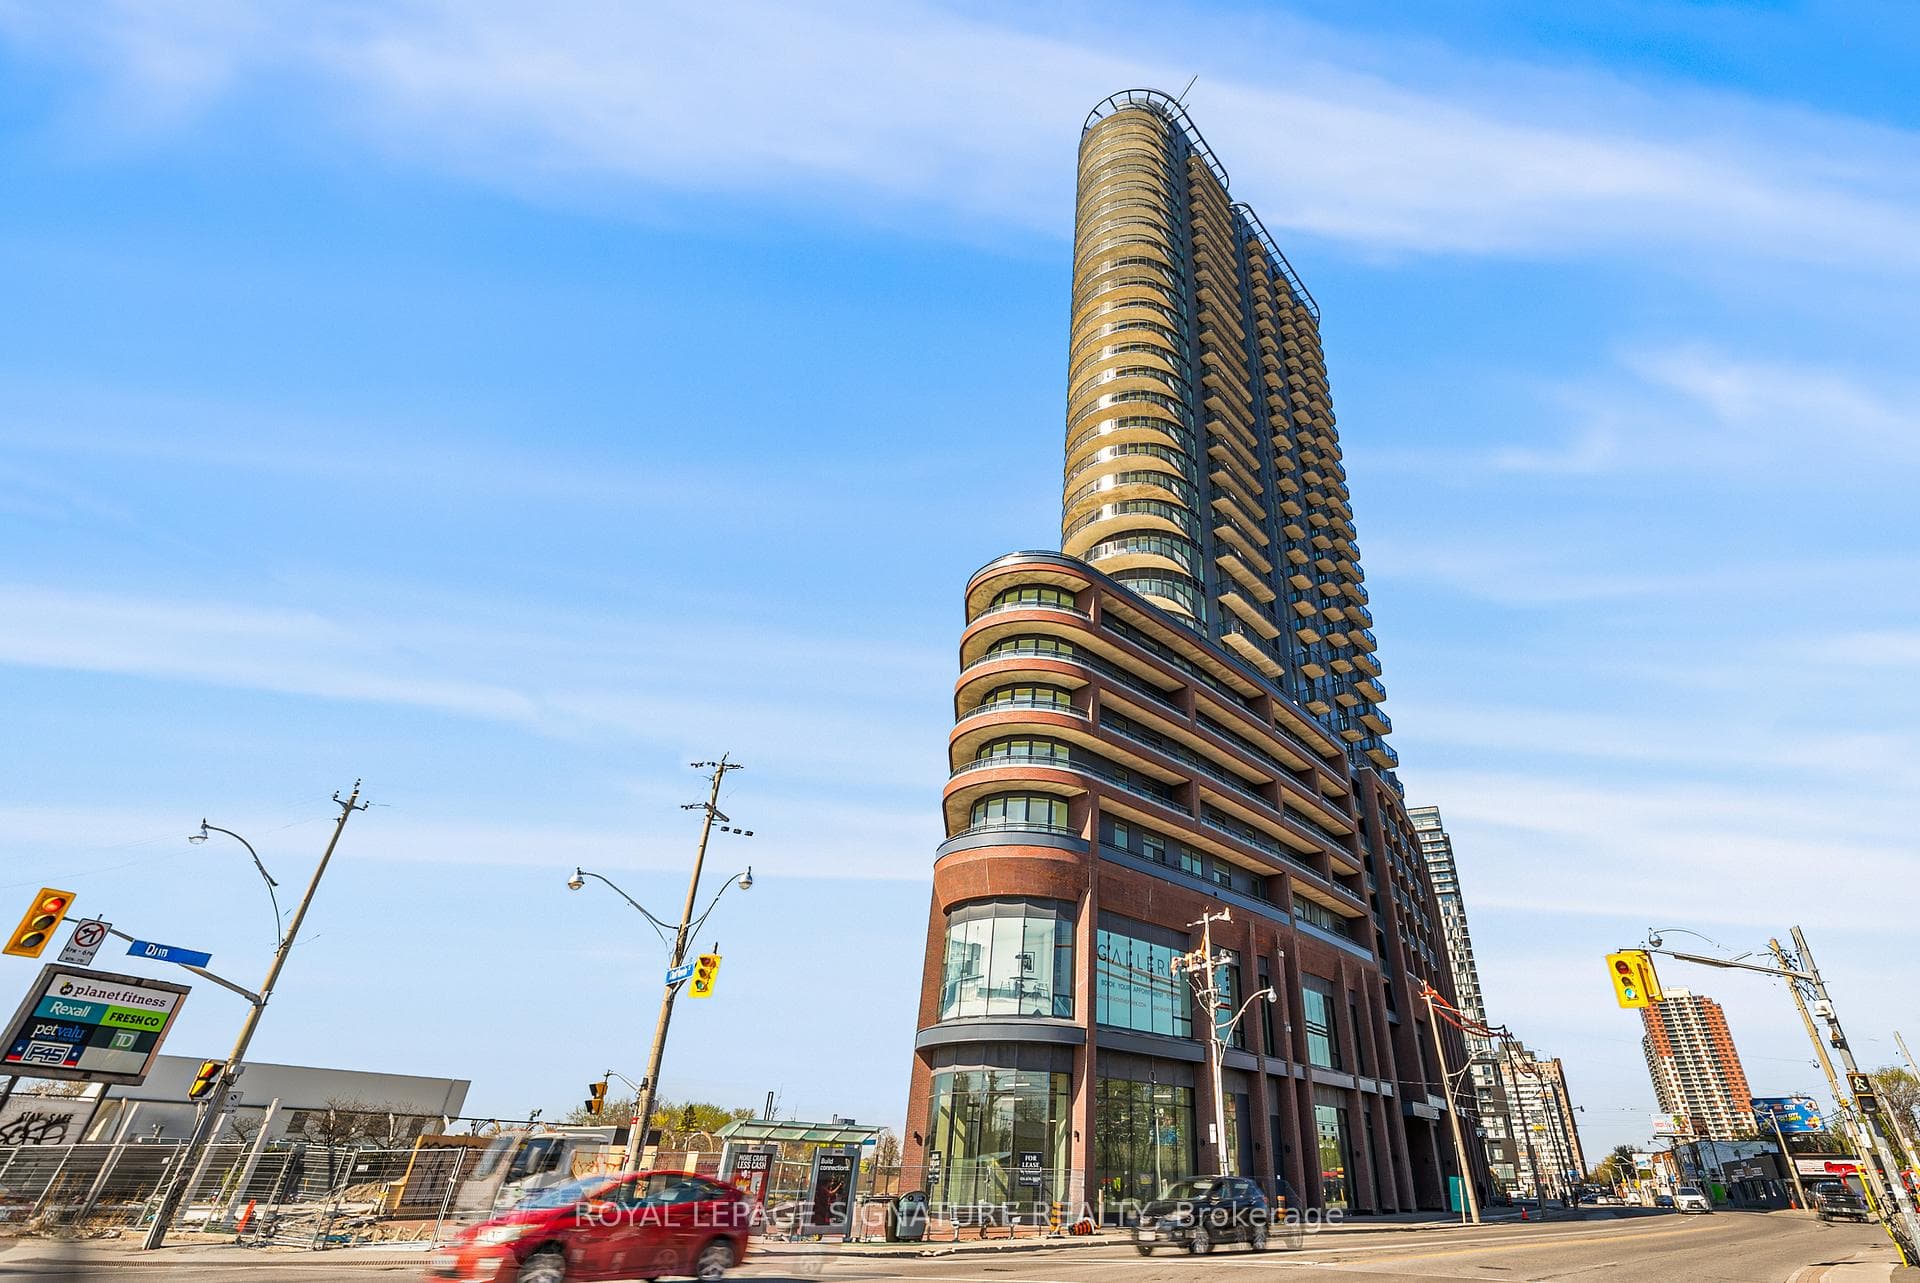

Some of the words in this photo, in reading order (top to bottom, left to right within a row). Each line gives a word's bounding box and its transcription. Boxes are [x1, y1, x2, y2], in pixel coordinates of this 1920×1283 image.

[1097, 944, 1176, 978] GALLERI
[49, 1001, 91, 1018] Rexall
[116, 1032, 135, 1048] TD
[24, 1044, 69, 1063] F45
[20, 1112, 43, 1121] STAY
[737, 1161, 751, 1169] LESS
[751, 1162, 767, 1170] CASH
